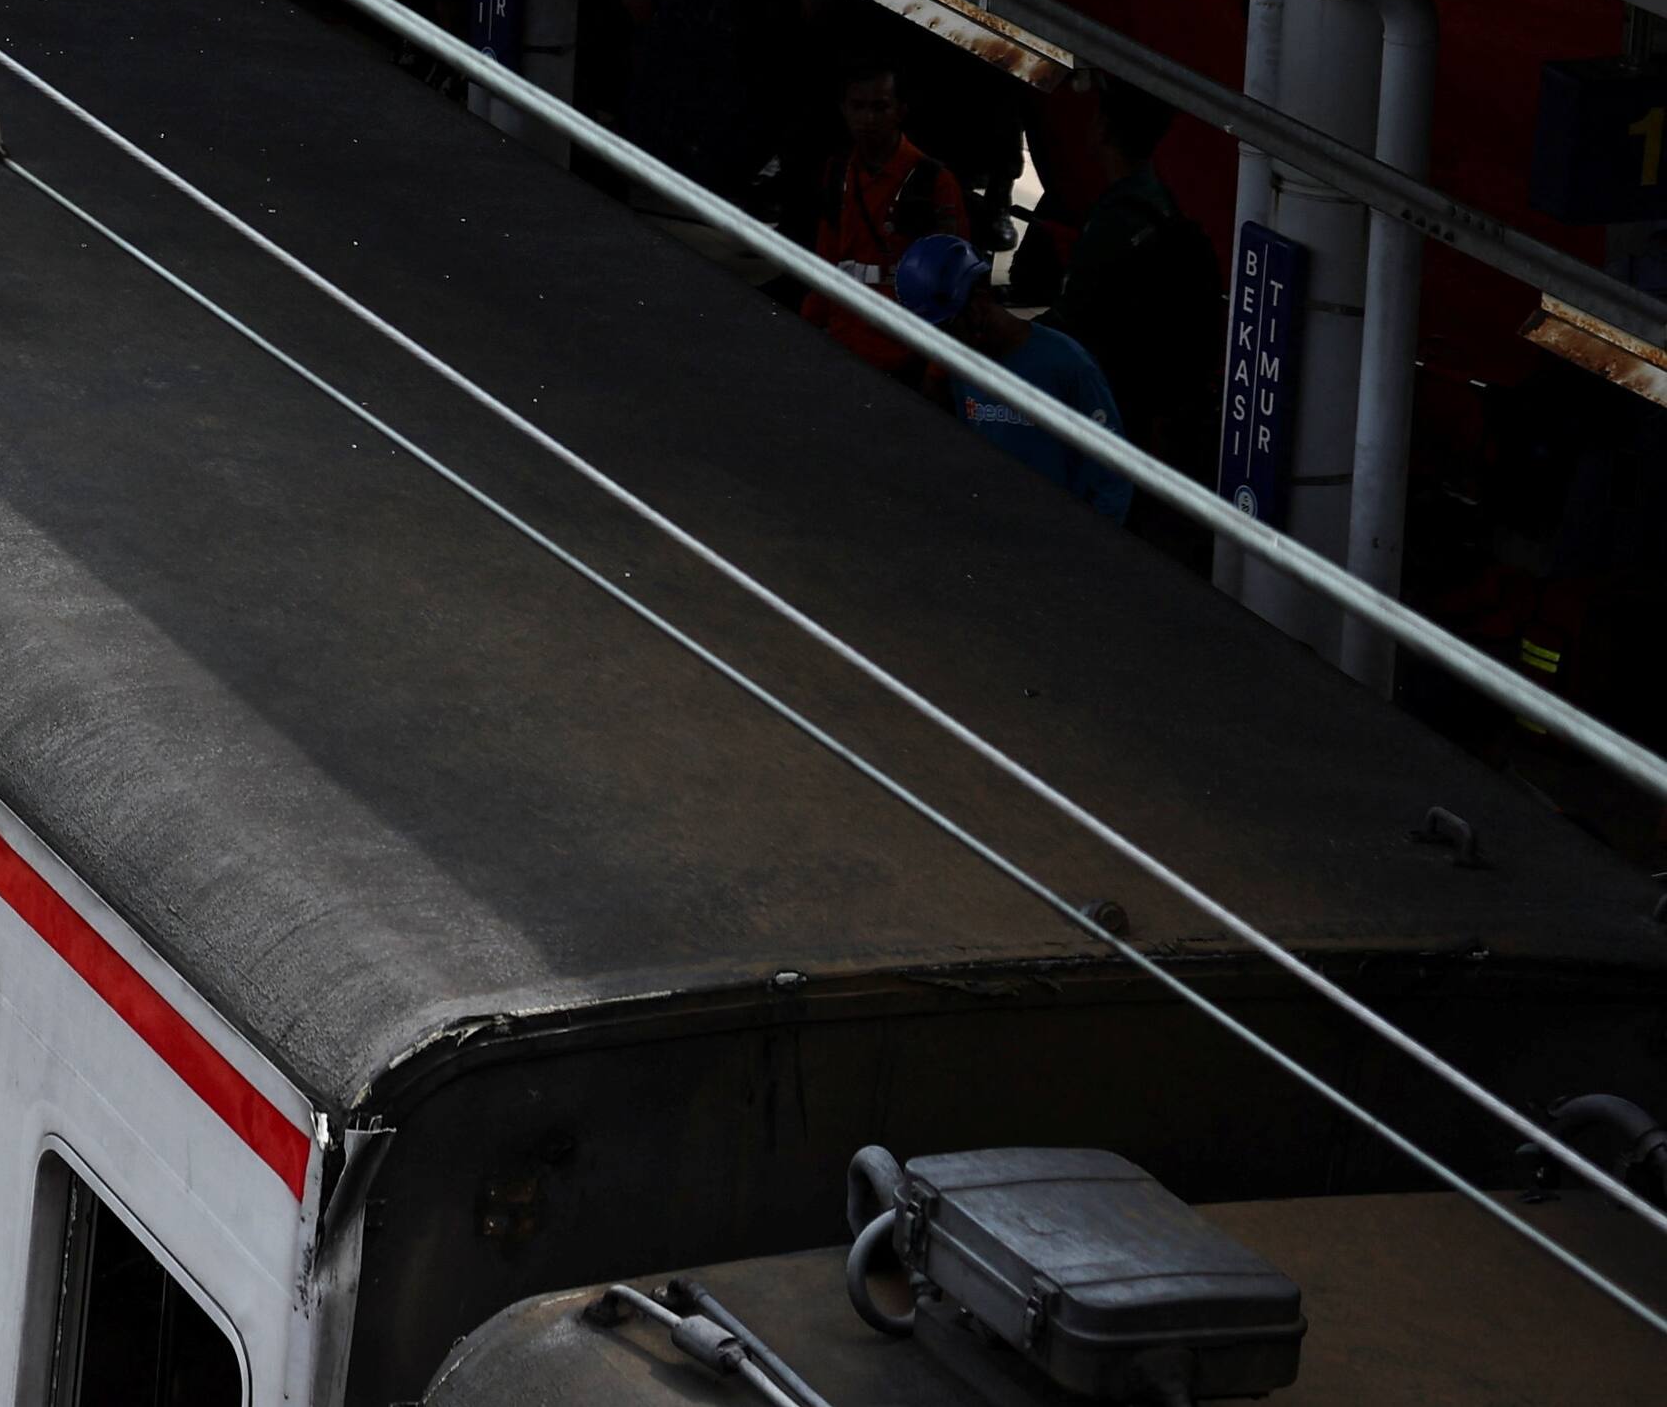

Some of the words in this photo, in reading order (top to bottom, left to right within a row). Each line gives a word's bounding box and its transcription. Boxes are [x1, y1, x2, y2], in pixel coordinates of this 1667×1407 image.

[1627, 106, 1666, 187] 1
[1232, 249, 1259, 456] BEKASI
[1257, 279, 1284, 454] TIMUR
